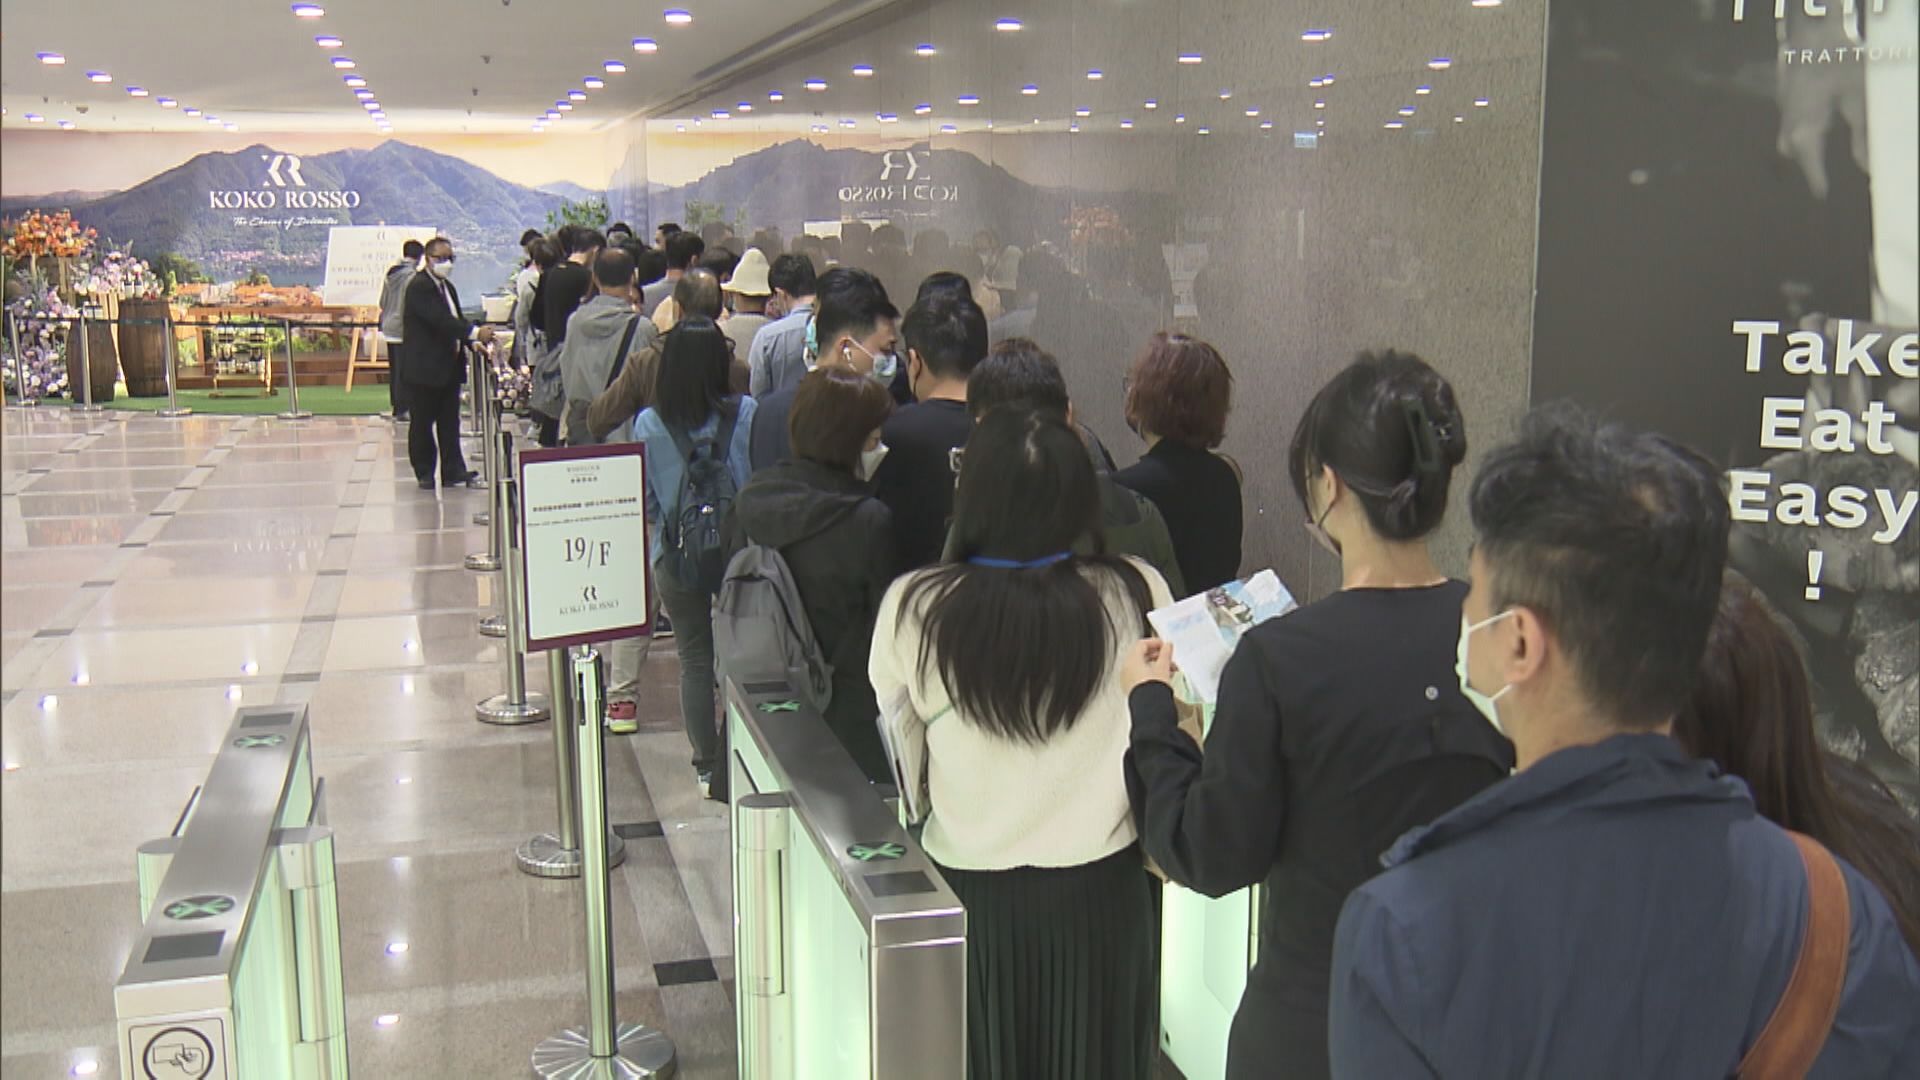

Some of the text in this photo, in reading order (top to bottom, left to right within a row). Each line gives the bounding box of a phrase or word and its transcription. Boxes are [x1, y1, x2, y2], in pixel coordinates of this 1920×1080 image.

[209, 190, 360, 209] KOKO ROSSO
[1732, 319, 1919, 378] Take
[1760, 397, 1896, 454] Eat
[1729, 470, 1919, 544] Easy
[564, 537, 611, 568] 19/F
[1805, 550, 1823, 600] !
